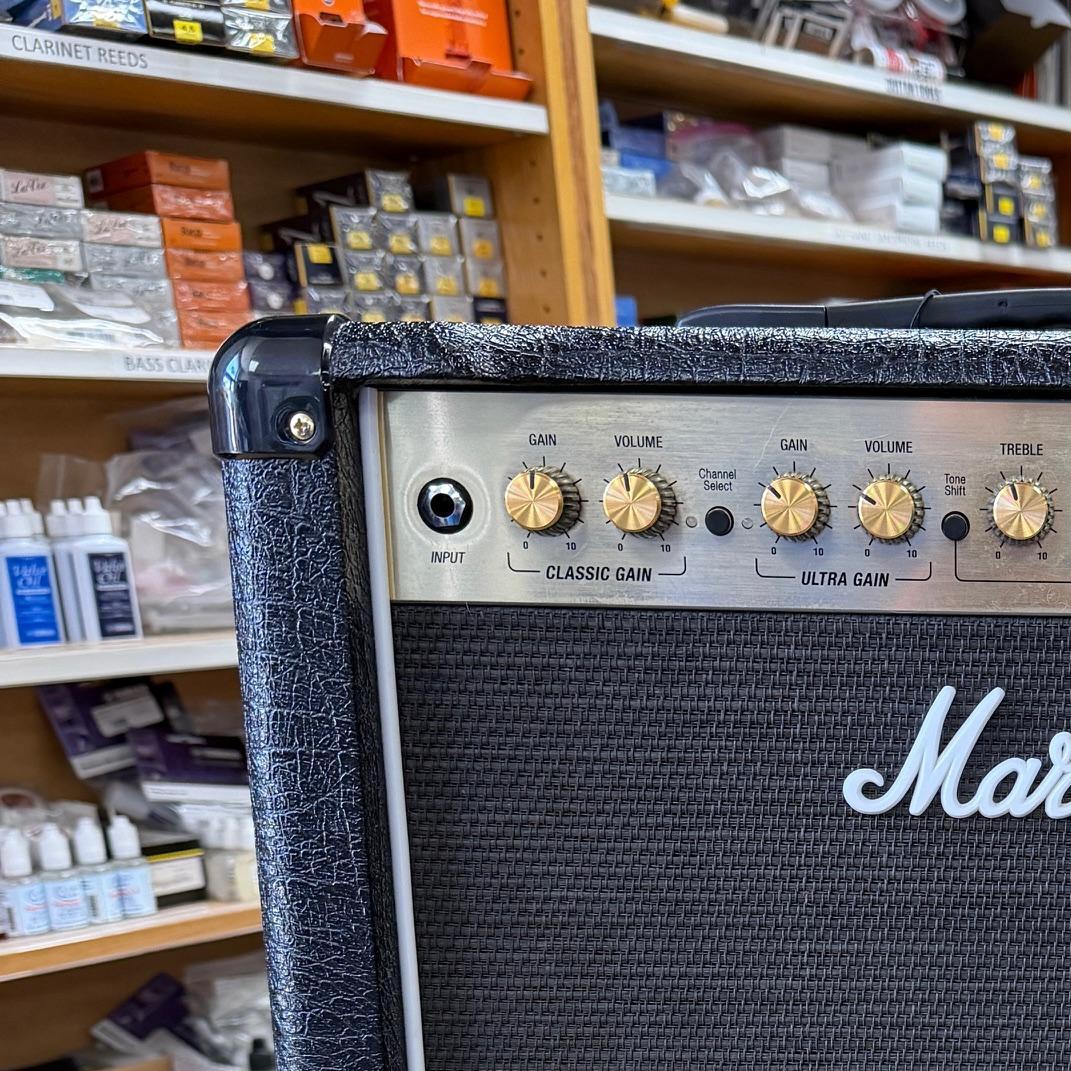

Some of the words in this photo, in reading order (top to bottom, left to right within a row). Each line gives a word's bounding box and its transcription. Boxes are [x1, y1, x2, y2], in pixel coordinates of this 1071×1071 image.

[11, 34, 92, 62] CLARINET
[98, 47, 149, 70] REEDS
[123, 356, 164, 373] BASS
[528, 433, 557, 446] GAIN
[614, 435, 663, 449] VOLUME
[780, 438, 808, 452] GAIN
[864, 440, 913, 454] VOLUME
[999, 442, 1044, 456] TREBLE
[698, 467, 737, 480] Channel
[944, 473, 966, 485] Tone
[703, 479, 733, 492] Select
[944, 484, 966, 497] Shift
[522, 540, 529, 550] 0
[565, 541, 577, 551] 10
[617, 542, 624, 552] 0
[660, 544, 671, 553] 10
[770, 546, 777, 555] 0
[813, 547, 824, 556] 10
[430, 551, 466, 564] INPUT
[864, 548, 871, 557] 0
[906, 549, 918, 558] 10
[995, 551, 1001, 560] 0
[1037, 551, 1048, 560] 10
[546, 565, 611, 581] CLASSIC
[615, 566, 652, 582] GAIN
[801, 570, 848, 587] ULTRA
[853, 572, 890, 587] GAIN
